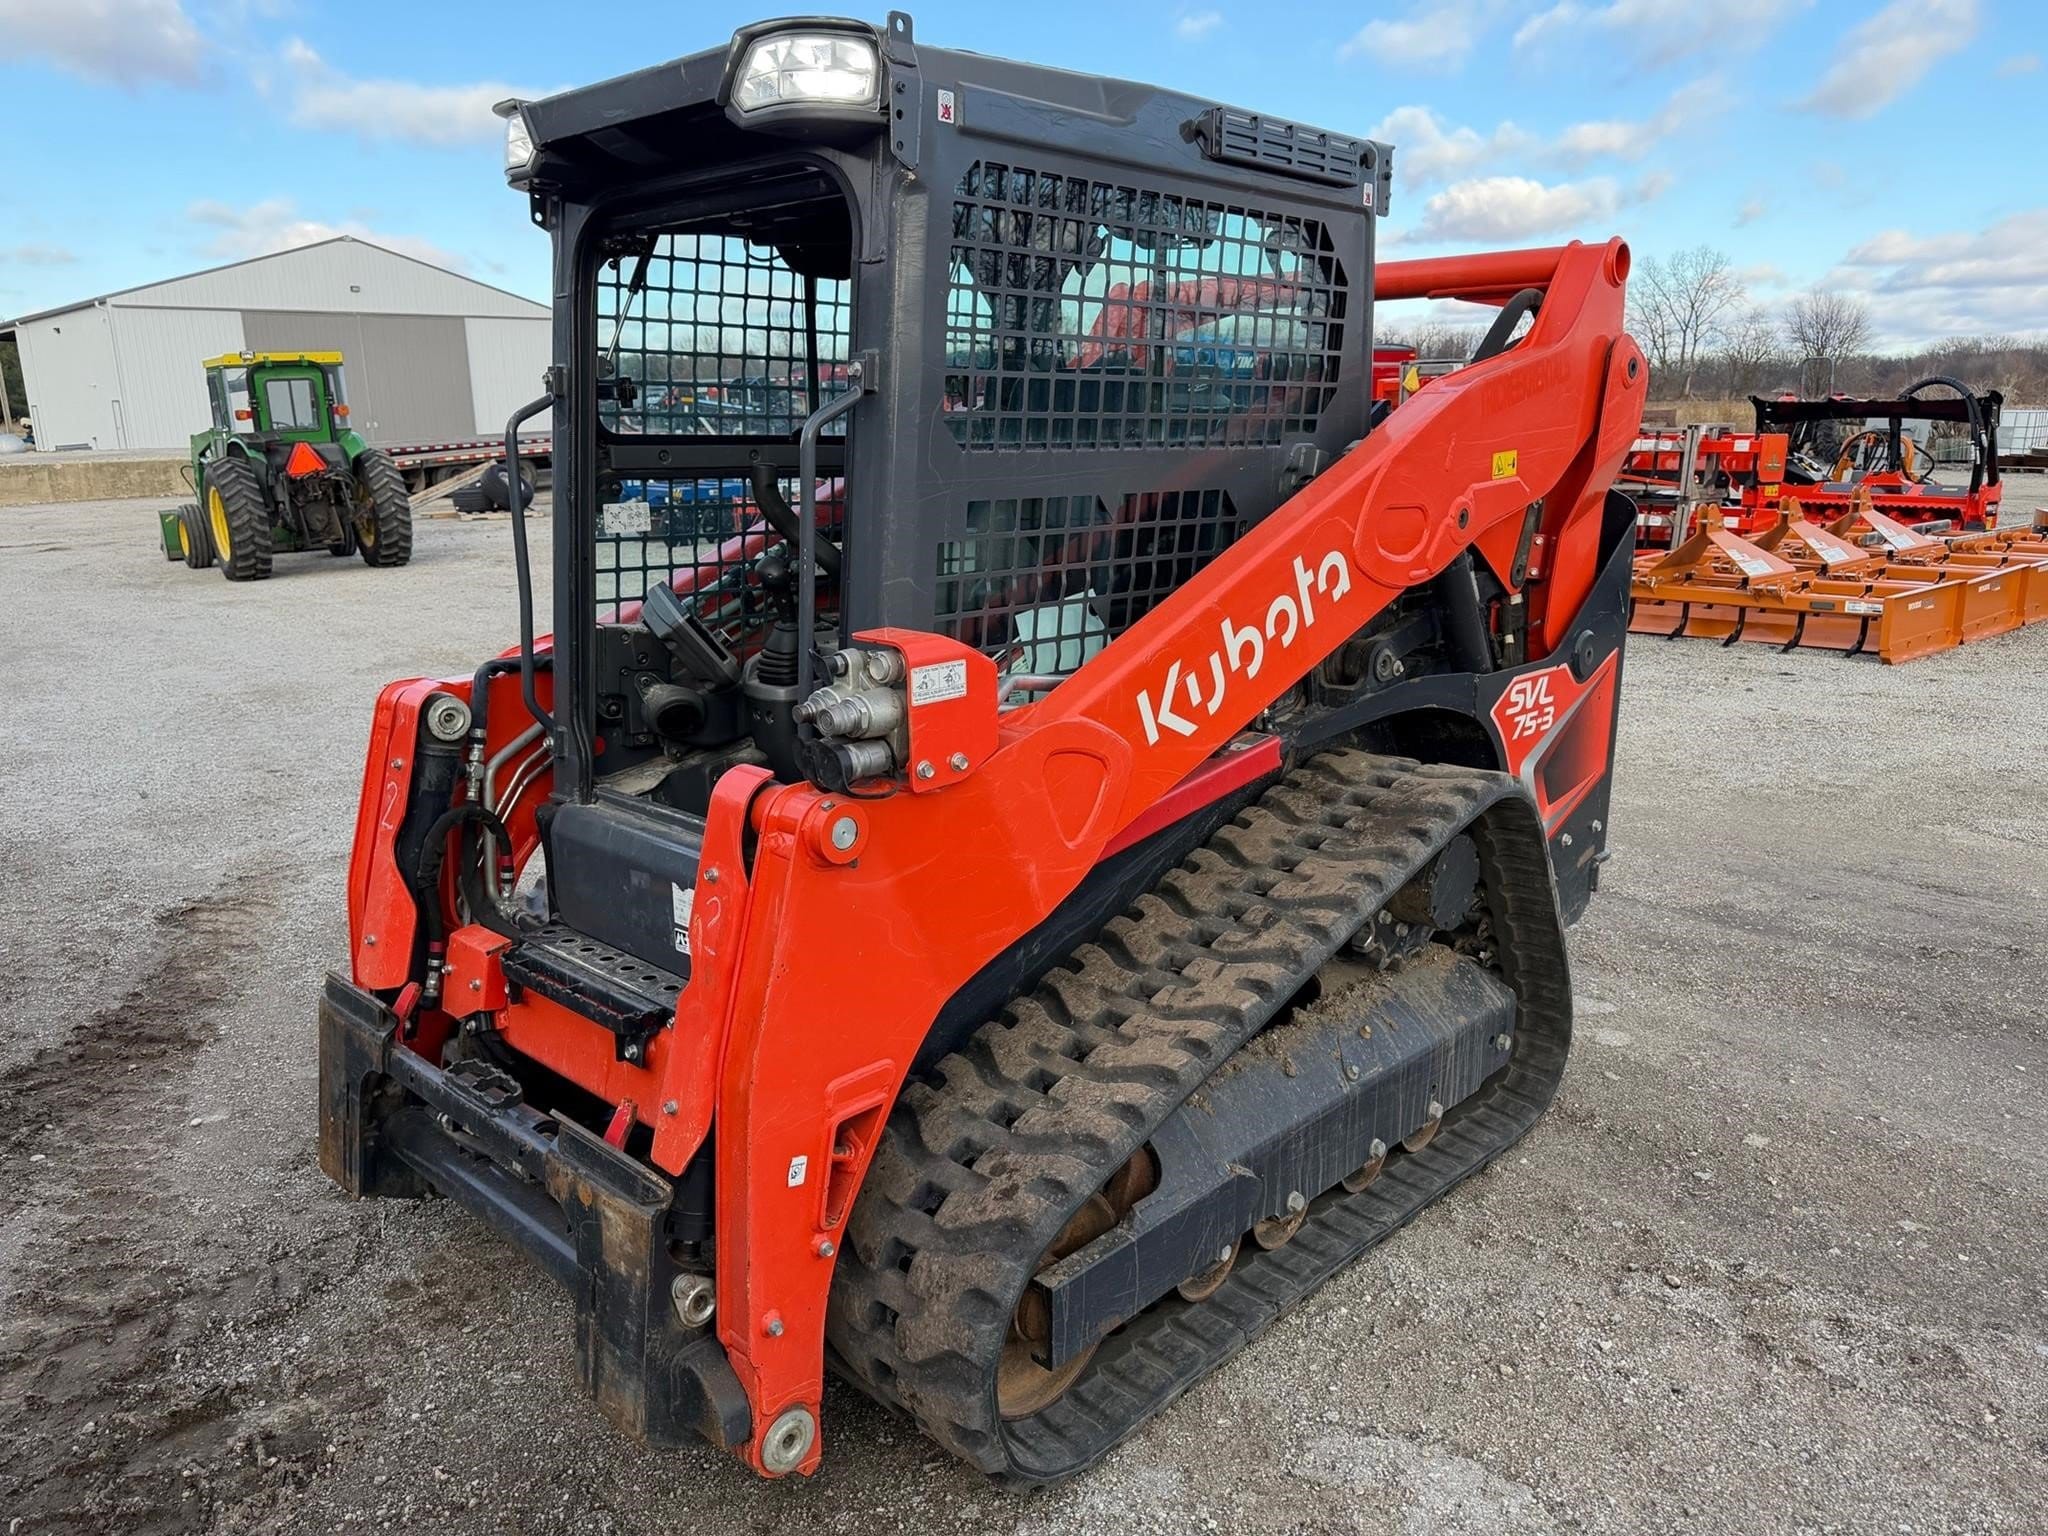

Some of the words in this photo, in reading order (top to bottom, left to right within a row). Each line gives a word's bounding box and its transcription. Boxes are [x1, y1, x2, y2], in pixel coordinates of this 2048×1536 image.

[1136, 550, 1352, 747] Kubota
[1505, 675, 1554, 716] SVL
[1512, 706, 1555, 741] 75-3
